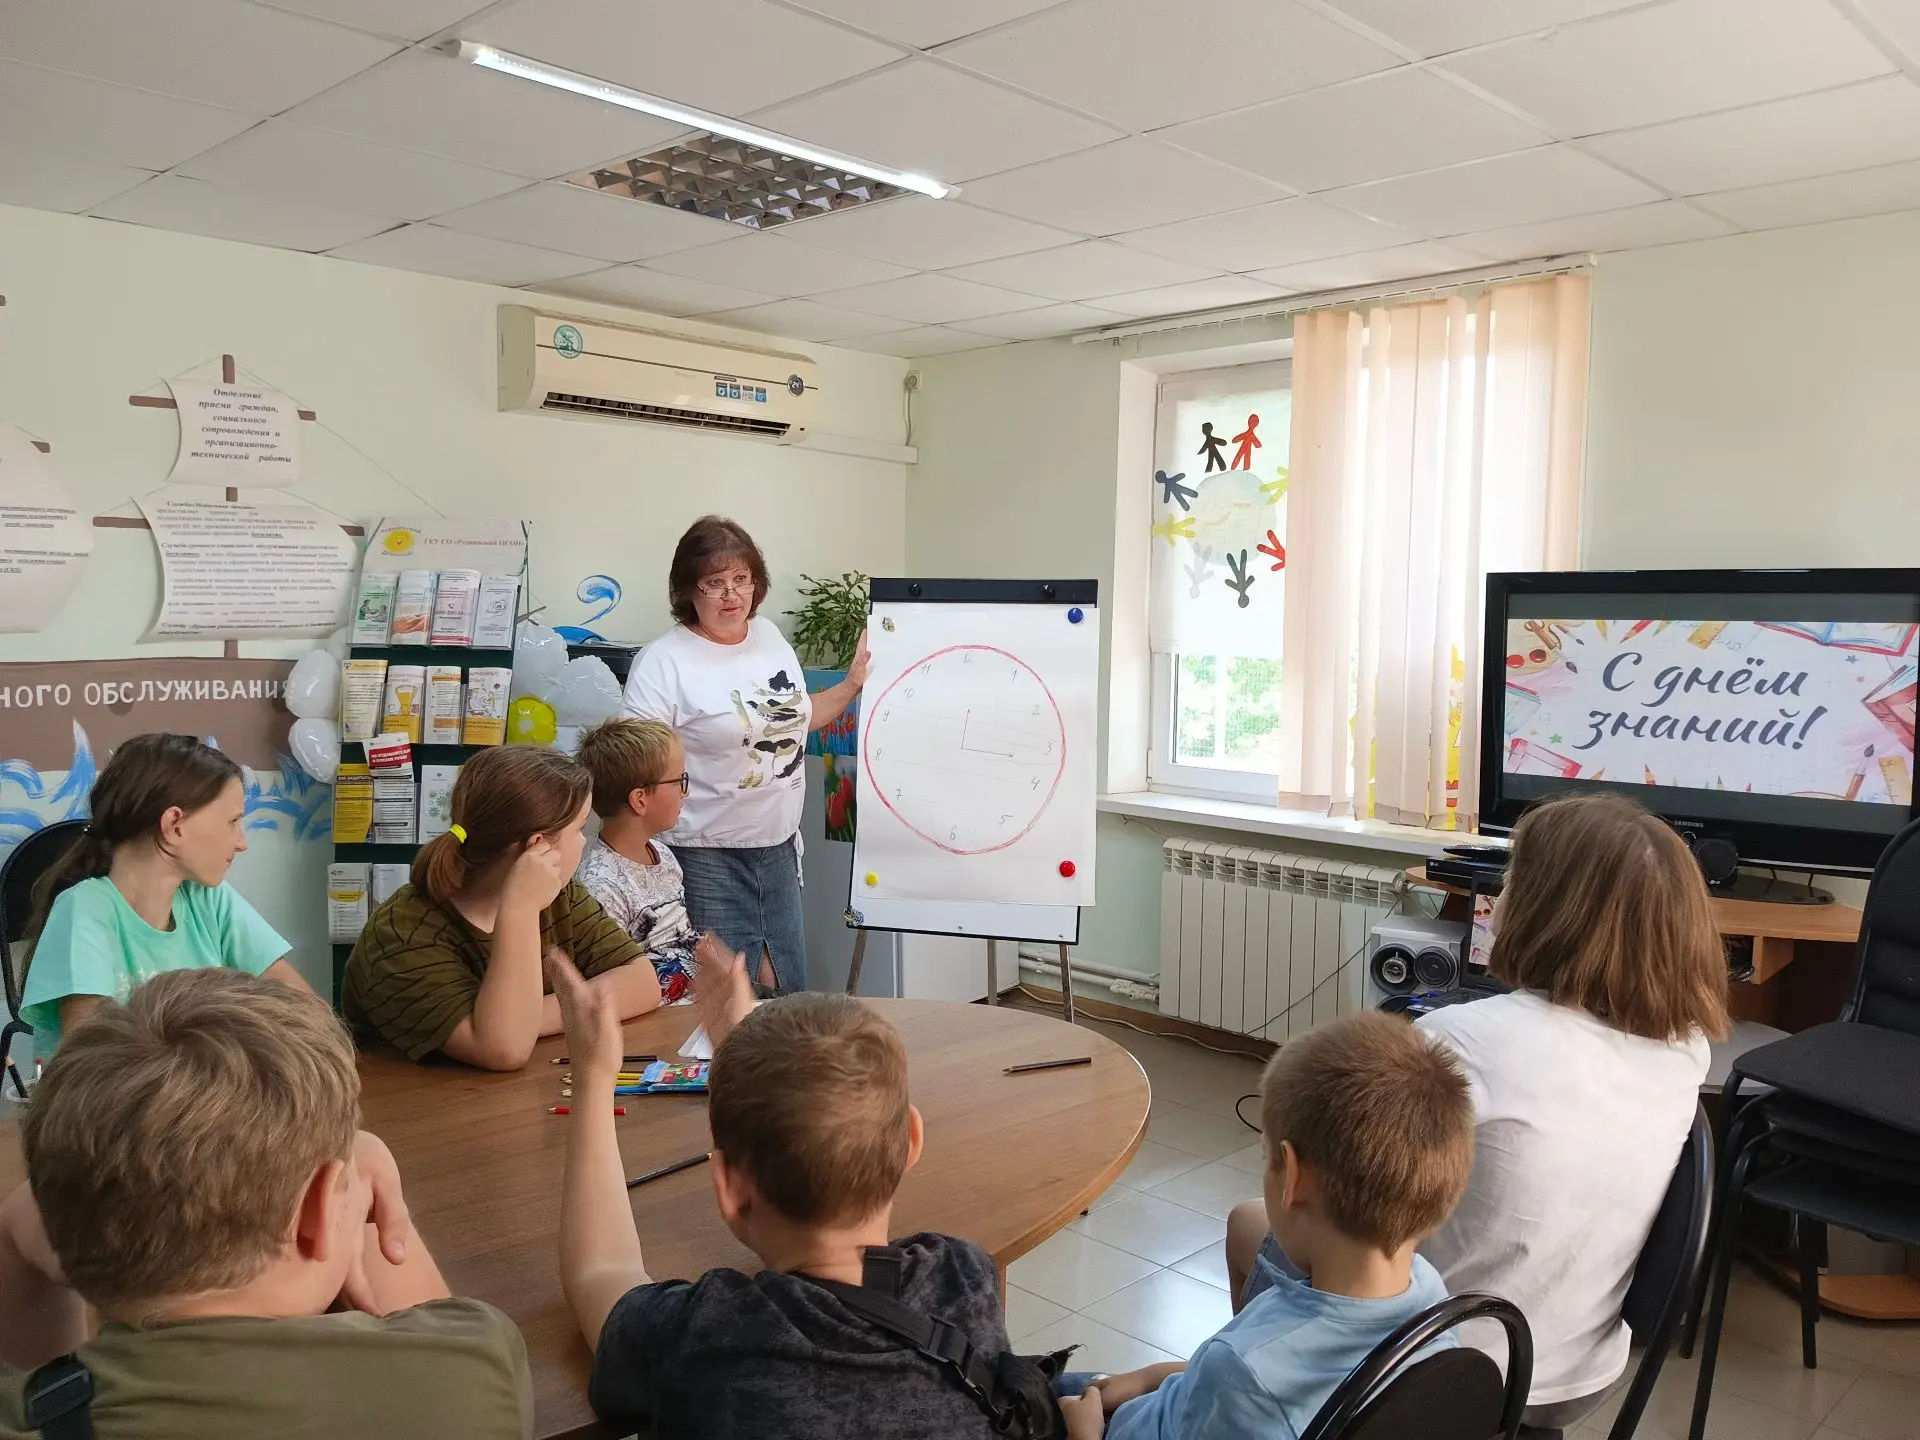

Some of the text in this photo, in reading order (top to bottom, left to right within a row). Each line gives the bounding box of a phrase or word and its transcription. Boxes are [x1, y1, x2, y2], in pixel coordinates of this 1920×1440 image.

[213, 388, 262, 399] Отделение
[198, 401, 279, 413] приема граждан,
[213, 414, 267, 424] социального
[201, 426, 270, 438] сопровождения
[205, 439, 278, 449] организационно-
[191, 451, 292, 463] технической работы
[1602, 652, 1808, 707] С днём
[1572, 705, 1828, 750] знаний!
[1031, 776, 1040, 791] 4
[949, 825, 957, 841] 6
